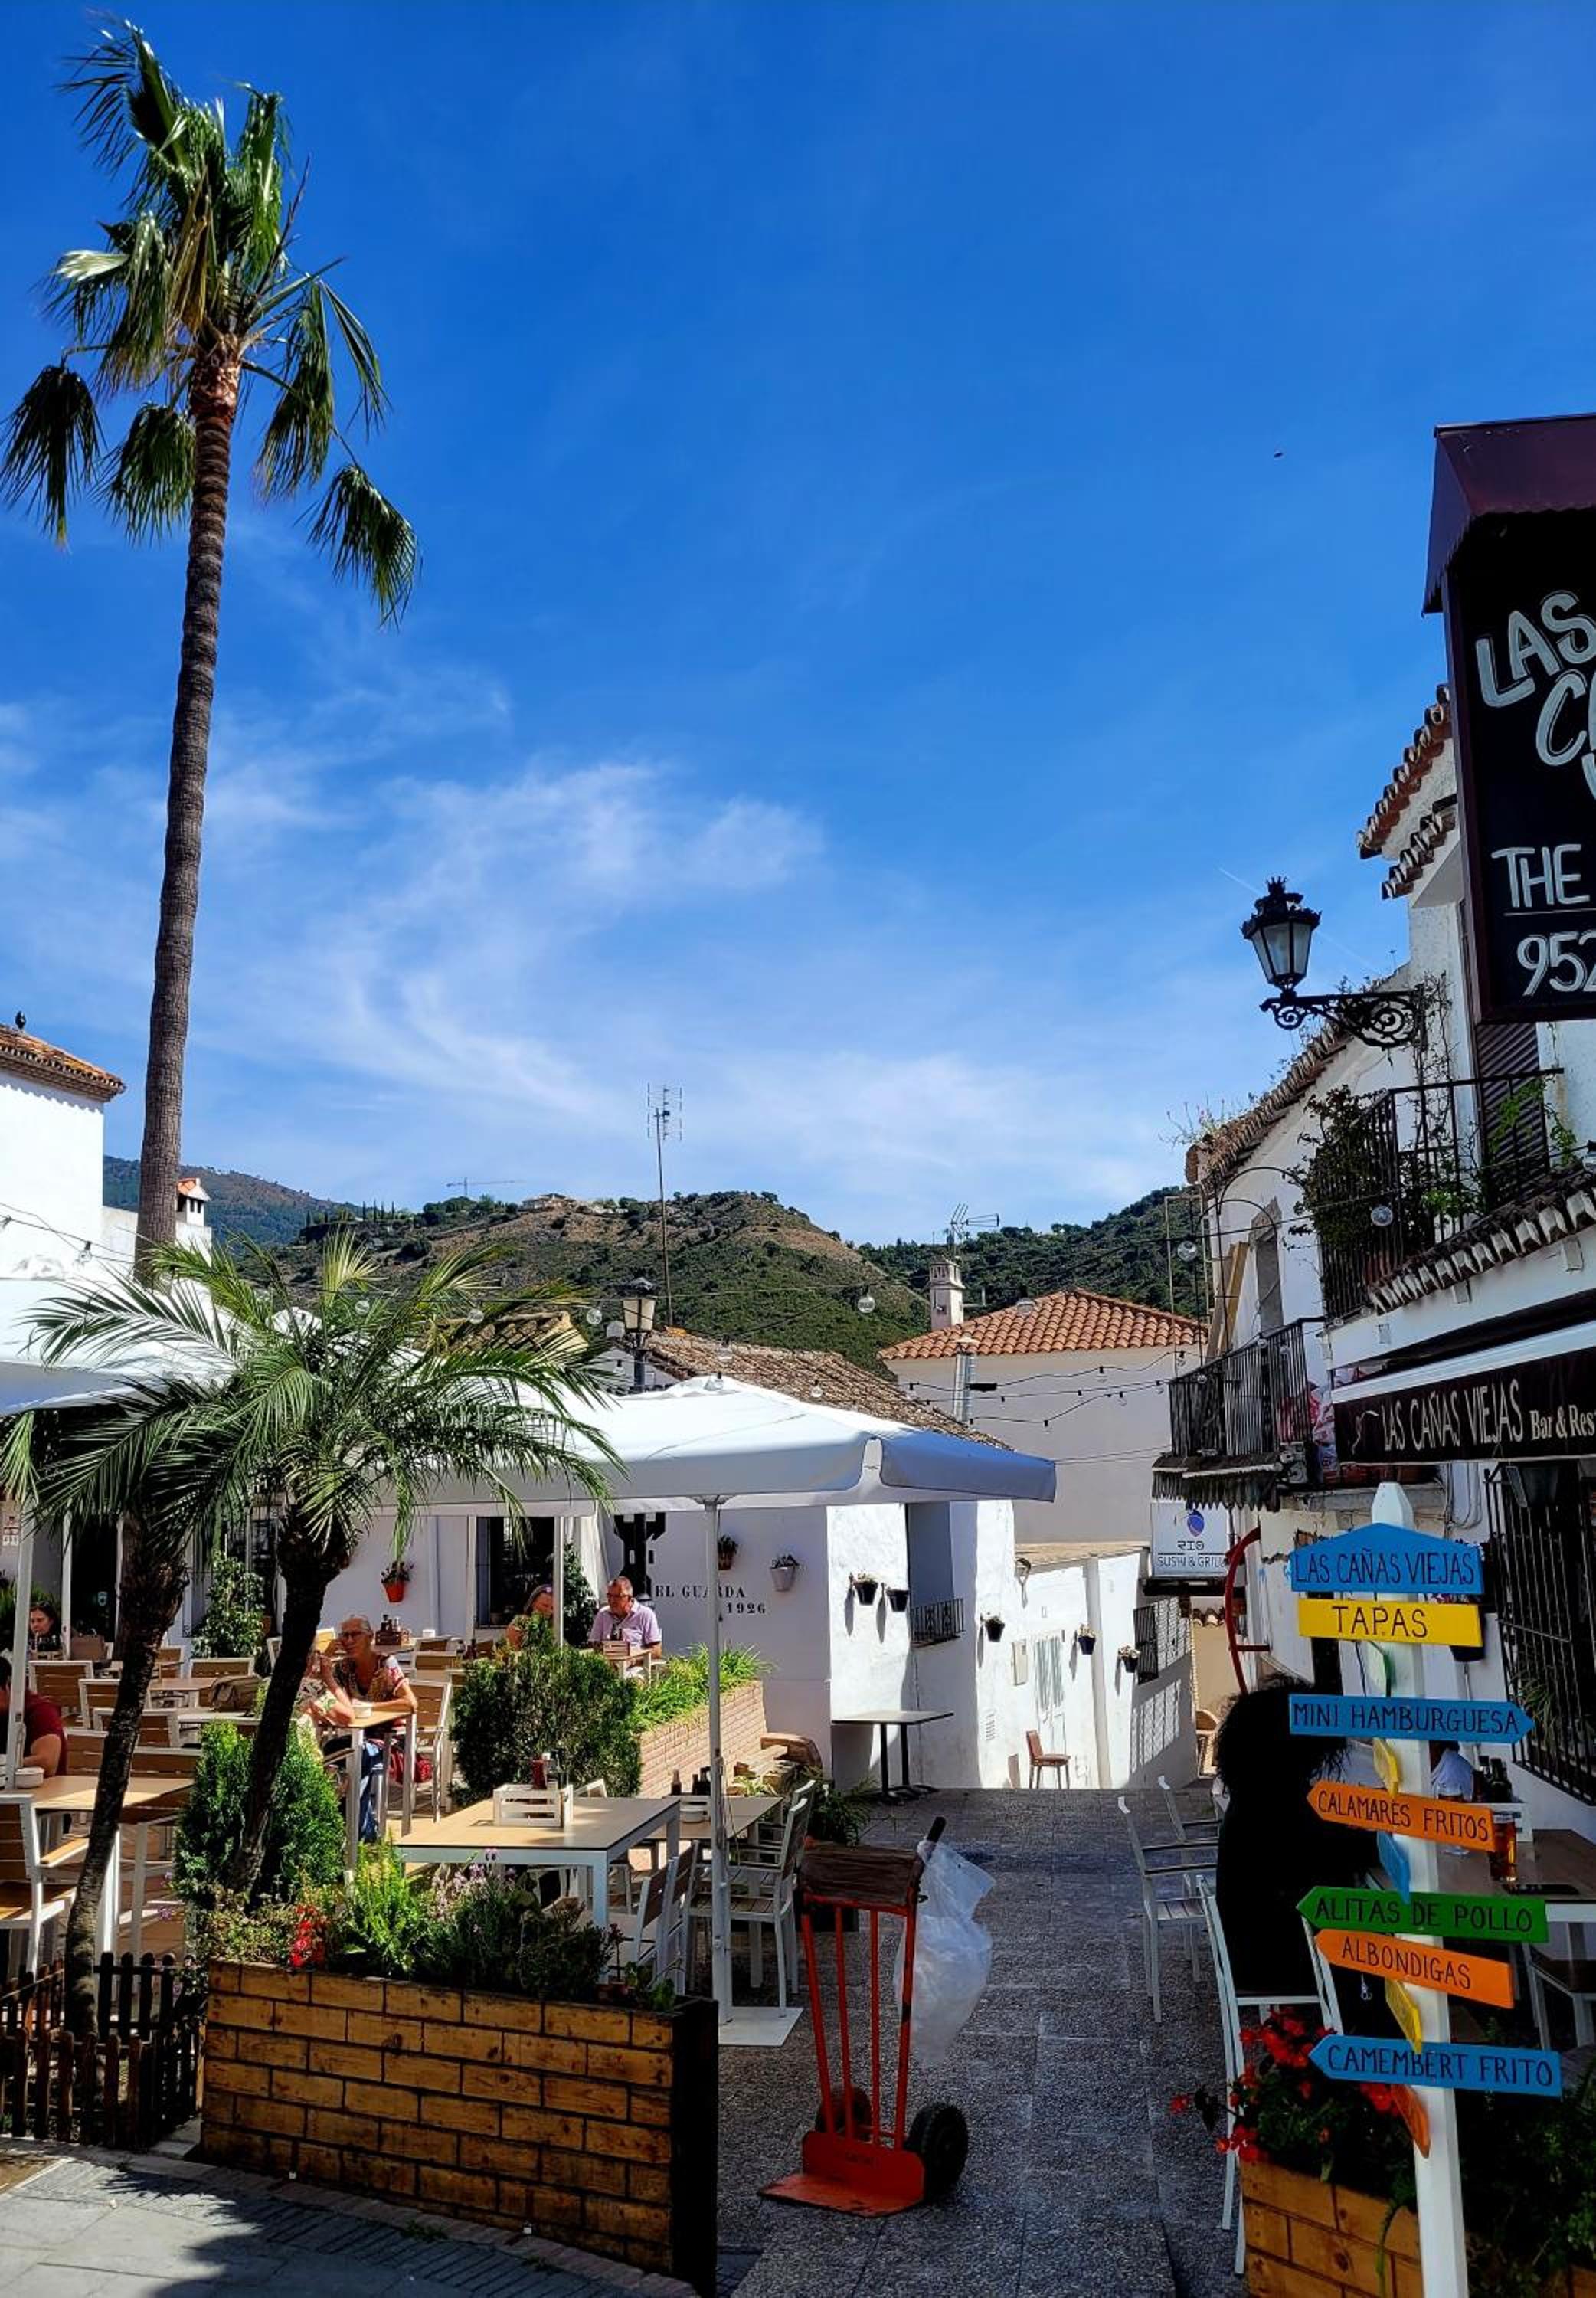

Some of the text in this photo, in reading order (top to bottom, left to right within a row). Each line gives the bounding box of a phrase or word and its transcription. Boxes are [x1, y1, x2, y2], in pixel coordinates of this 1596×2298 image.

[1475, 589, 1596, 707] LAS
[1491, 843, 1590, 908] THE
[1382, 1379, 1596, 1451] LAS CAÑAS VIEJAS Bar & Res
[1157, 1556, 1186, 1567] SUSHI
[1188, 1556, 1195, 1567] &
[1294, 1548, 1475, 1585] LAS CAÑAS VIEJAS
[656, 1585, 675, 1597] EL
[727, 1602, 766, 1614] 1926
[1333, 1606, 1428, 1638] TAPAS
[1293, 1701, 1520, 1735] MINI HAMBURGUESA
[1318, 1790, 1488, 1842] CALAMARES FRITOS
[1315, 1897, 1532, 1933] ALITAS DE POLLO
[1341, 1936, 1471, 1990] ALBONDIGAS
[1327, 2044, 1553, 2087] CAMEMBERT FRITO
